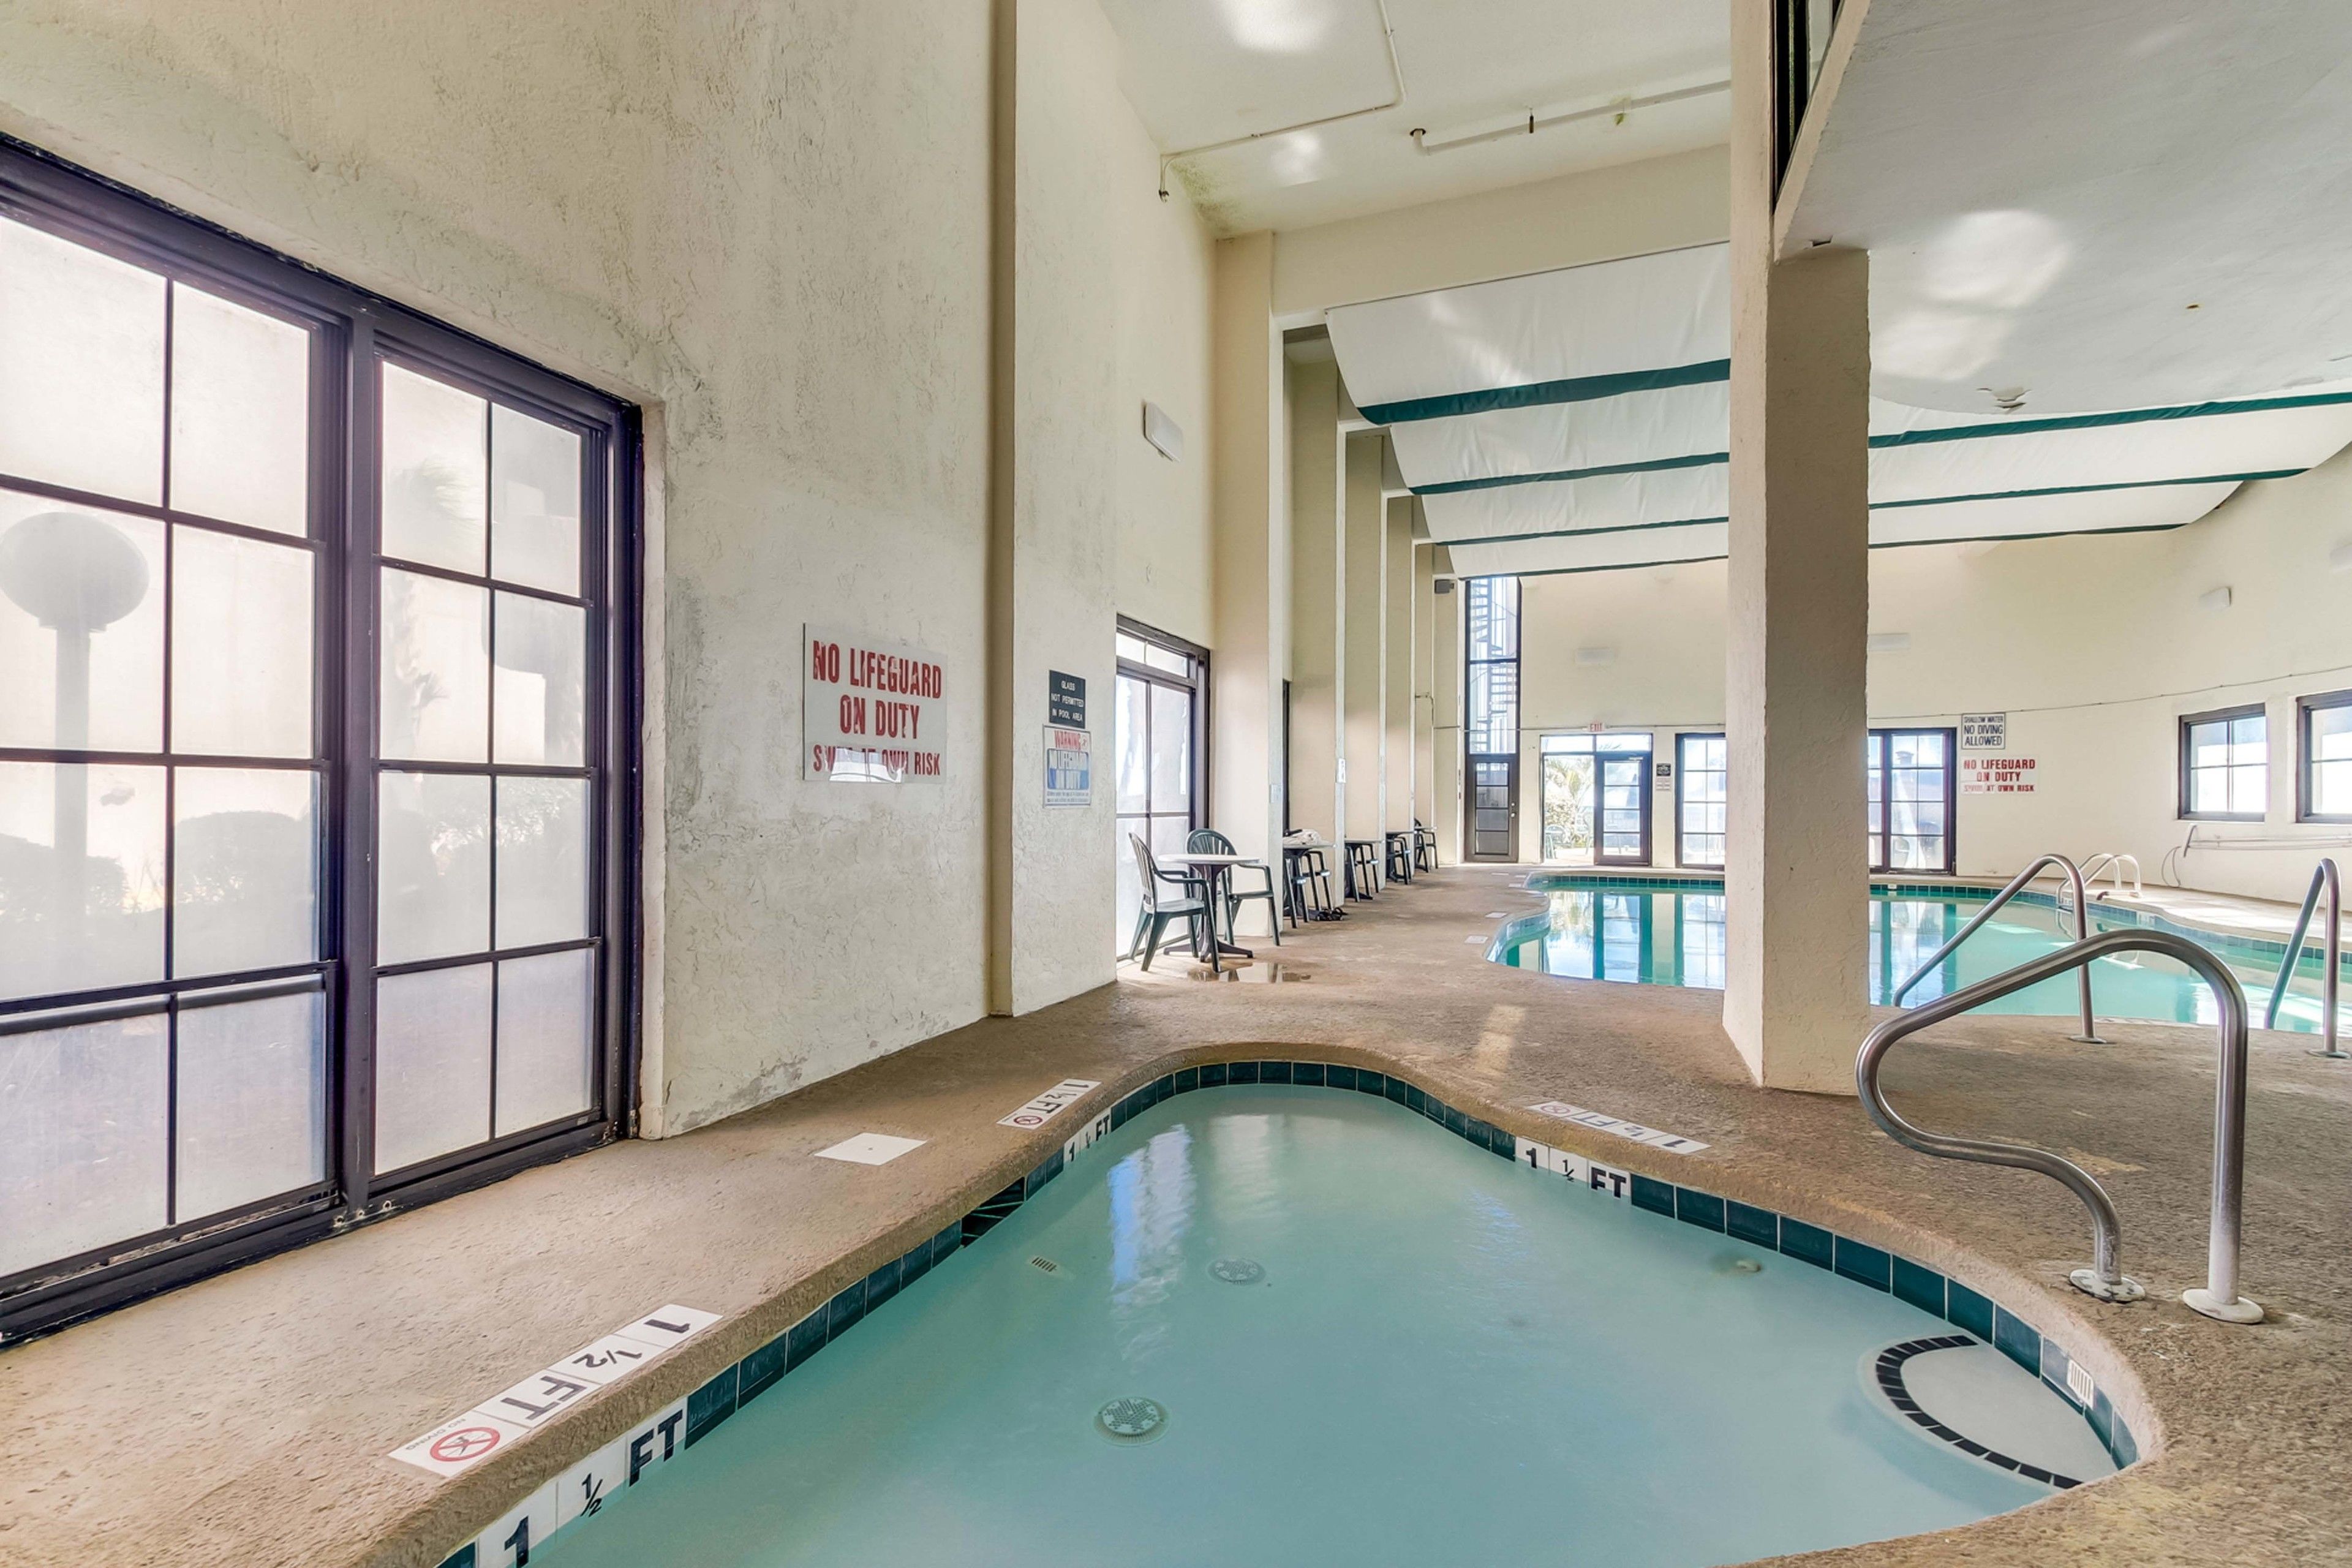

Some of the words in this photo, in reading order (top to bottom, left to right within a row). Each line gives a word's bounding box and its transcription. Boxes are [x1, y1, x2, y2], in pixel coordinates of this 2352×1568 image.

[813, 640, 840, 684] NO
[850, 648, 941, 699] LIFEGUARD
[1061, 680, 1075, 691] GLASS
[1051, 693, 1060, 702] NOT
[1062, 695, 1084, 707] PERMITTED
[840, 695, 865, 734] ON
[875, 699, 920, 739] DUTY
[1058, 709, 1070, 719] POOL
[1072, 712, 1083, 722] AREA
[1964, 725, 1975, 734] NO
[1978, 725, 2003, 734] DIVING
[1965, 736, 2002, 746] ALLOWED
[914, 752, 940, 775] RISK
[1964, 760, 1977, 769] NO
[1981, 759, 2035, 769] LIFEGUARD
[1977, 772, 1989, 782] ON
[1996, 771, 2021, 782] DUTY
[1027, 1100, 1063, 1114] FT
[1069, 1142, 1075, 1162] 1
[1096, 1115, 1110, 1141] FT
[1526, 1147, 1537, 1169] 1
[1591, 1166, 1627, 1198] FT
[643, 1318, 691, 1335] 1
[500, 1375, 588, 1420] FT
[505, 1516, 530, 1568] 1
[629, 1409, 683, 1487] FT
